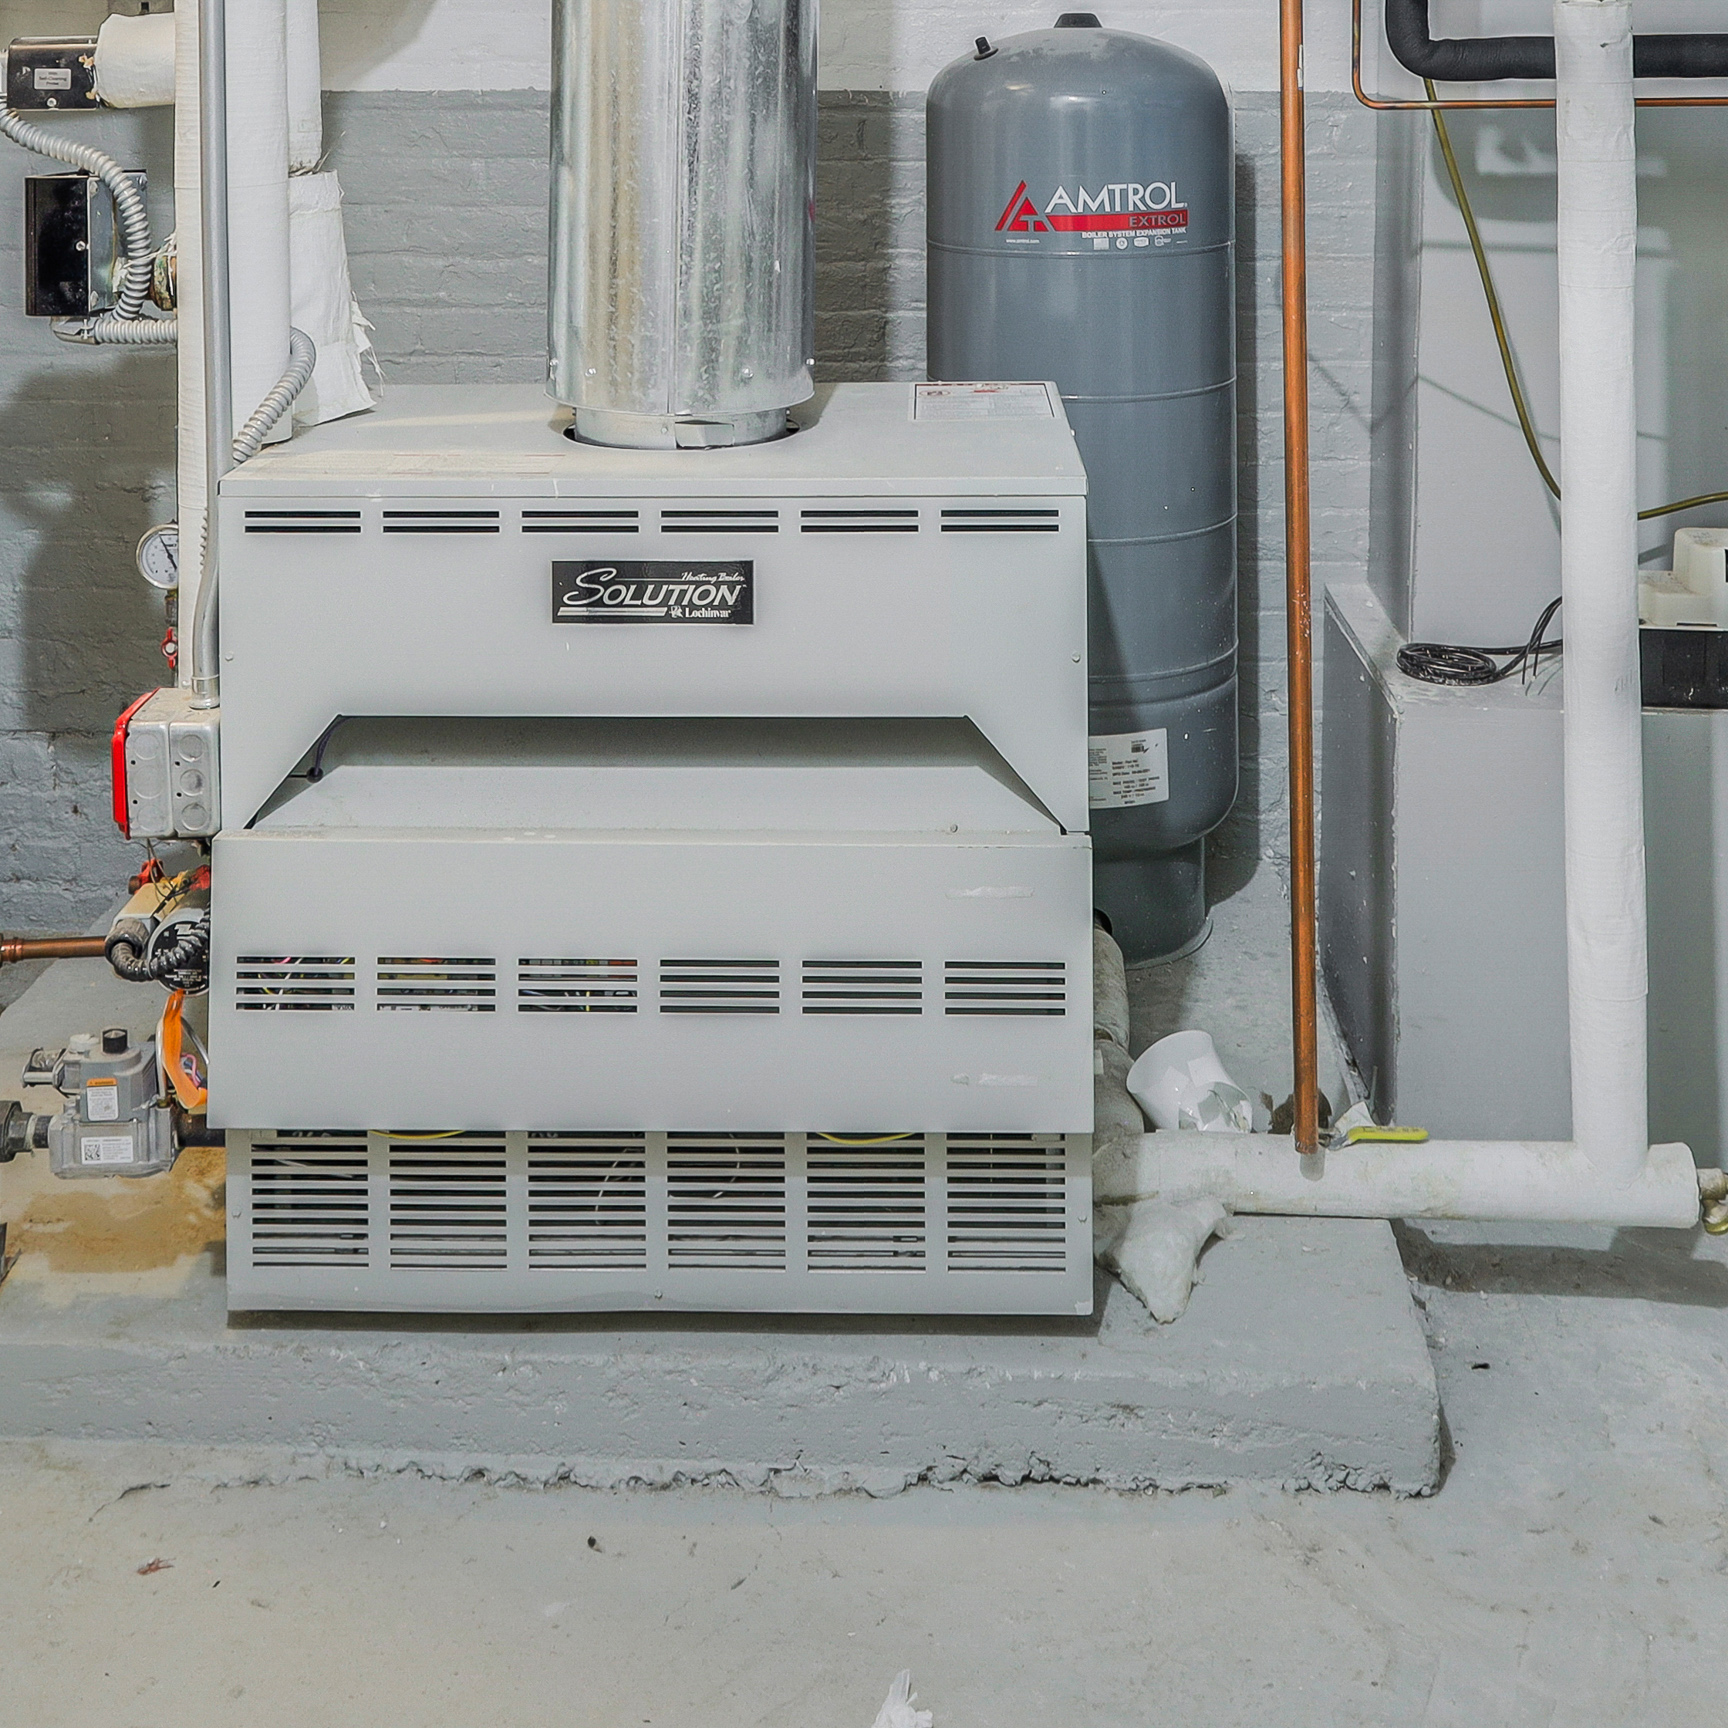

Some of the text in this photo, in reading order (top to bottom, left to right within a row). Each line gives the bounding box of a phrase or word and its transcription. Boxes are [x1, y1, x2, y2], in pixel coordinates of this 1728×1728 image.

[1044, 181, 1188, 214] AMTROL
[1129, 213, 1186, 228] EXTROL
[1082, 231, 1108, 239] BOILER
[1109, 230, 1135, 238] SYSTEM
[1136, 229, 1171, 237] EXPANSION
[681, 571, 745, 584] Heating Boiler
[562, 567, 742, 606] SOLUTION
[685, 607, 732, 618] Lochinvar
